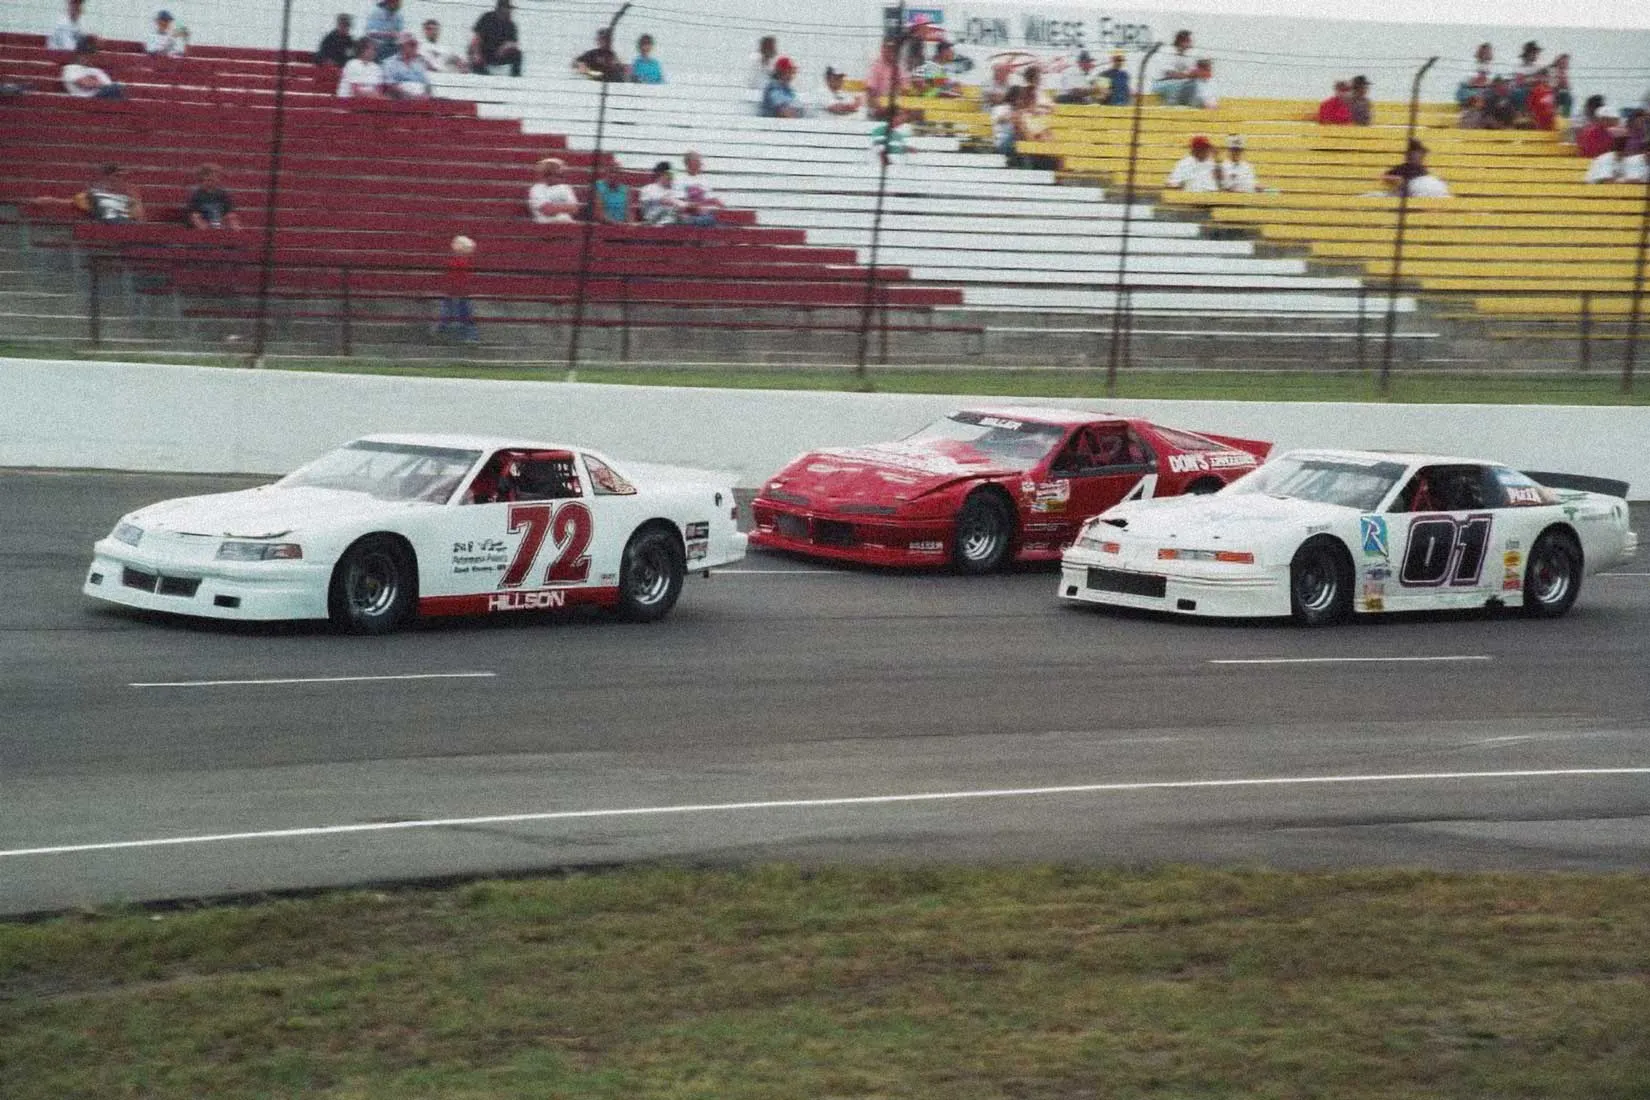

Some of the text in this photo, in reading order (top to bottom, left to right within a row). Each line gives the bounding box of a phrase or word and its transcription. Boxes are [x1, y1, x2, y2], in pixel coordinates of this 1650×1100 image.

[497, 501, 593, 589] 72
[1401, 514, 1493, 587] 01
[488, 590, 565, 612] HILLSON
